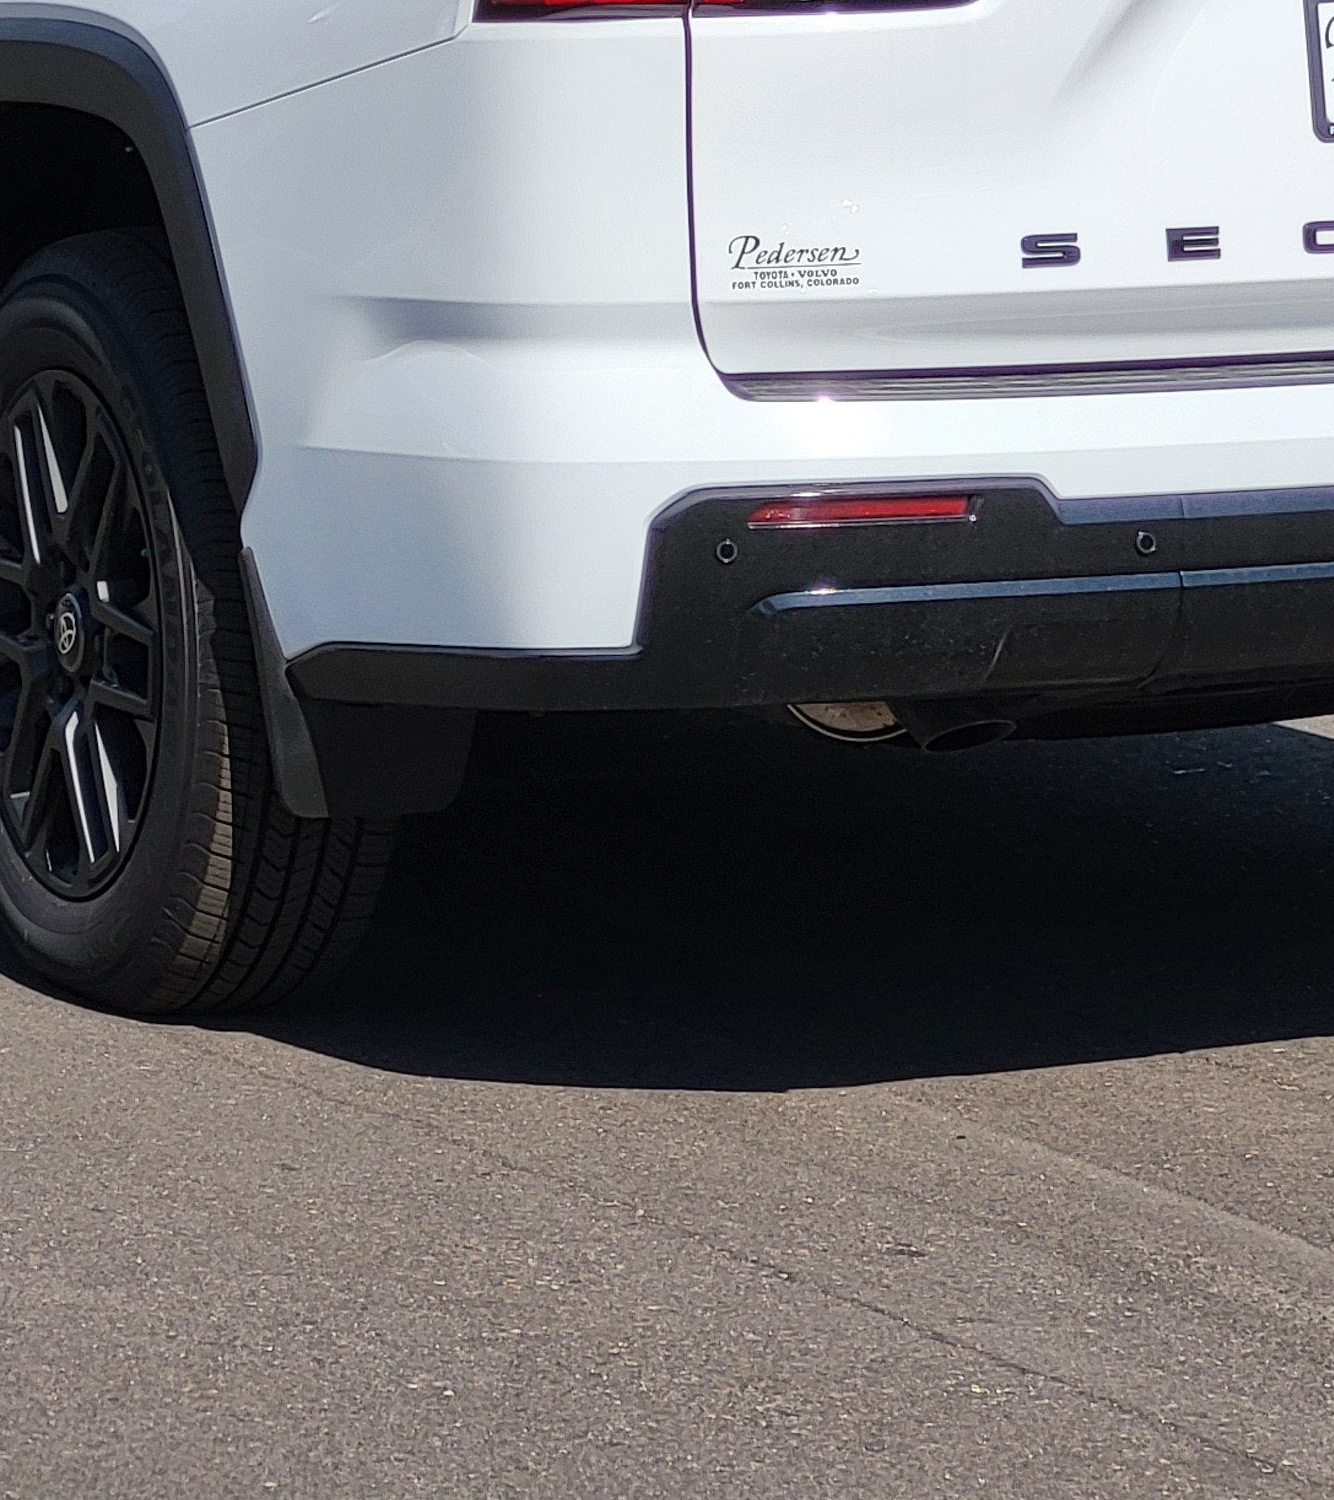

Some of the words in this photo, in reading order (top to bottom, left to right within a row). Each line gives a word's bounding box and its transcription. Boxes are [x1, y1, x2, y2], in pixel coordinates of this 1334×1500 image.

[728, 235, 860, 270] Pedersen
[754, 270, 788, 280] TOYOTA
[797, 269, 838, 278] VOLVO
[732, 281, 757, 289] FORT
[807, 277, 860, 287] COLORADO
